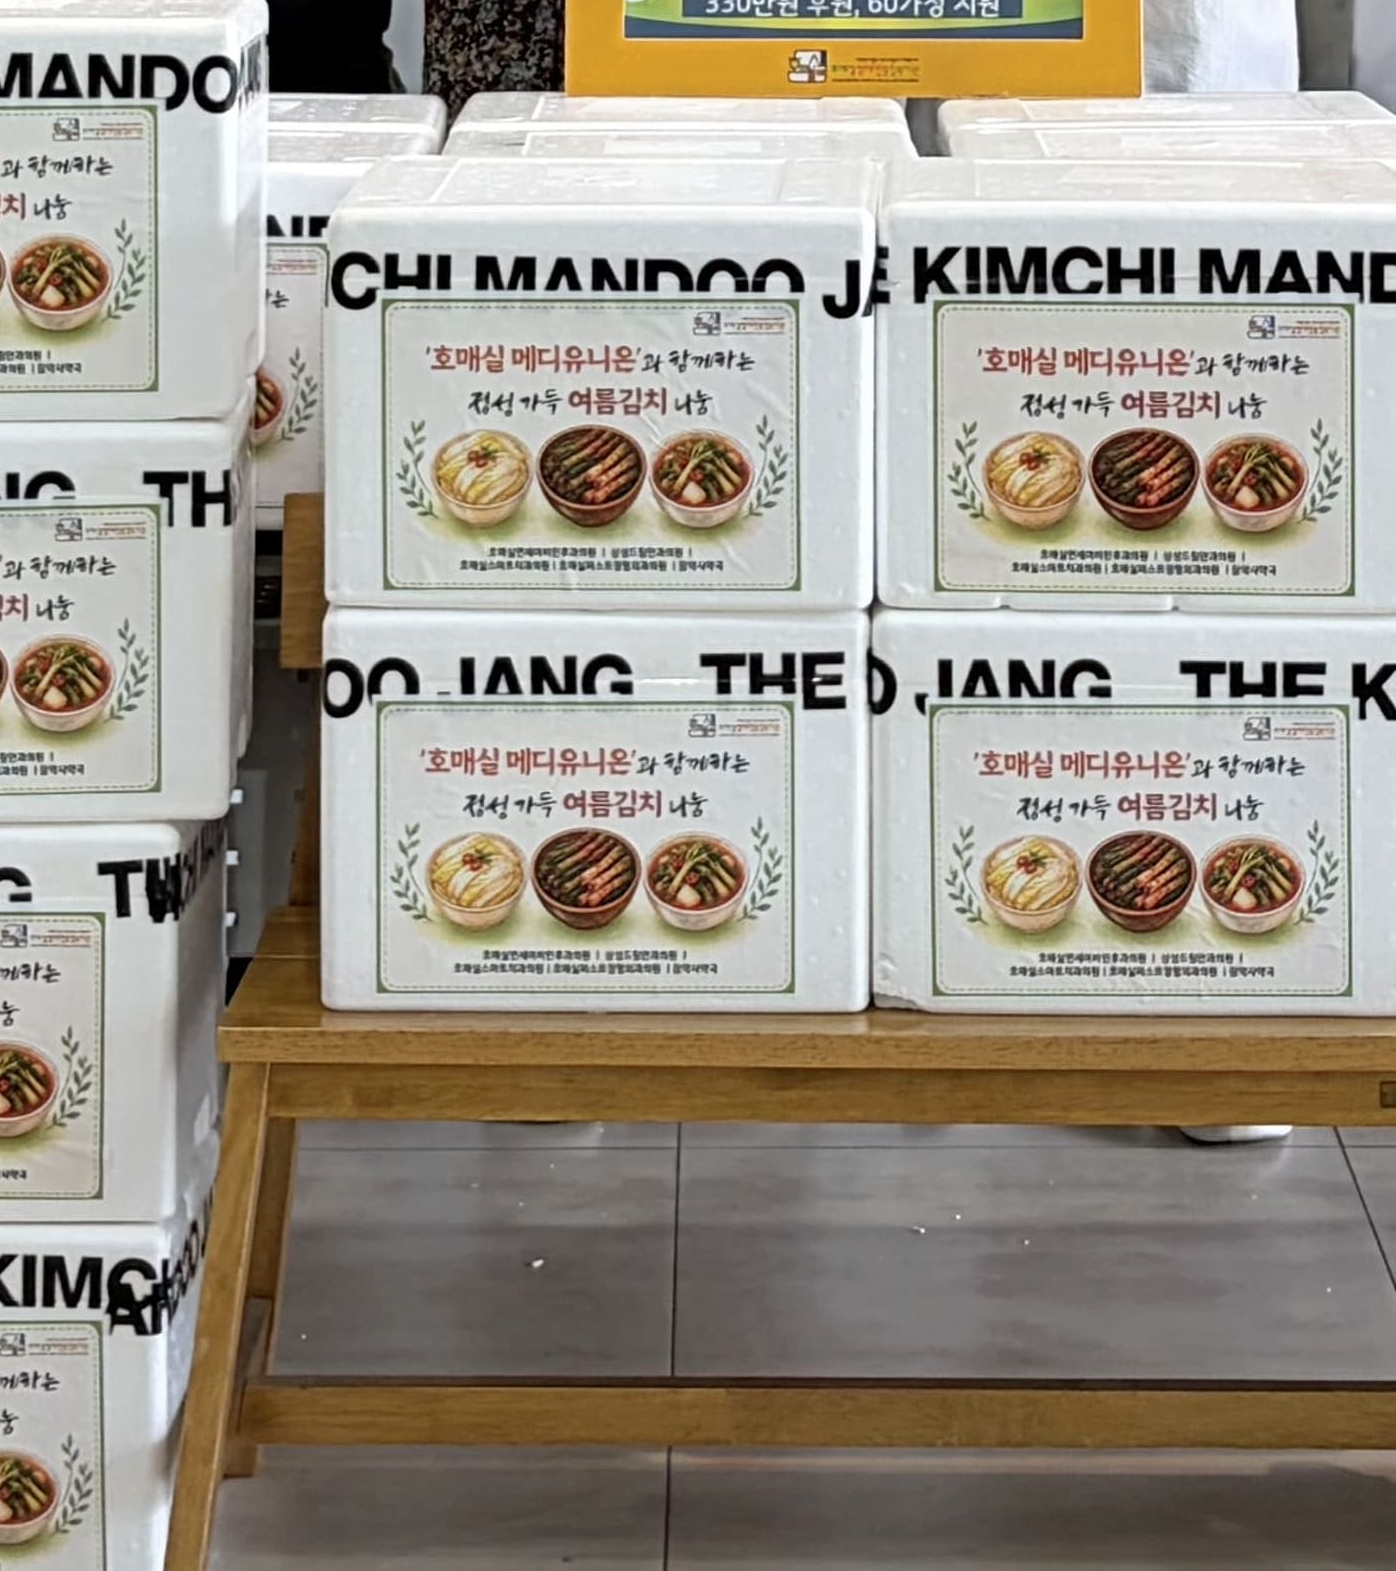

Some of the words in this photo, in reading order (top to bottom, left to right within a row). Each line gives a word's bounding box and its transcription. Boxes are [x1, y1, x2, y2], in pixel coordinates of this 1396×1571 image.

[331, 251, 451, 310] CHI
[913, 246, 1175, 303] KIMCHI
[467, 390, 515, 418] 정성
[567, 386, 667, 416] 여름김치
[1019, 393, 1067, 420] 정성
[1120, 389, 1221, 420] 여름김치
[700, 652, 847, 710] THE
[462, 793, 510, 820] 정성
[562, 789, 662, 819] 여름김치
[1016, 796, 1064, 824] 정성
[1117, 792, 1217, 822] 여름김치
